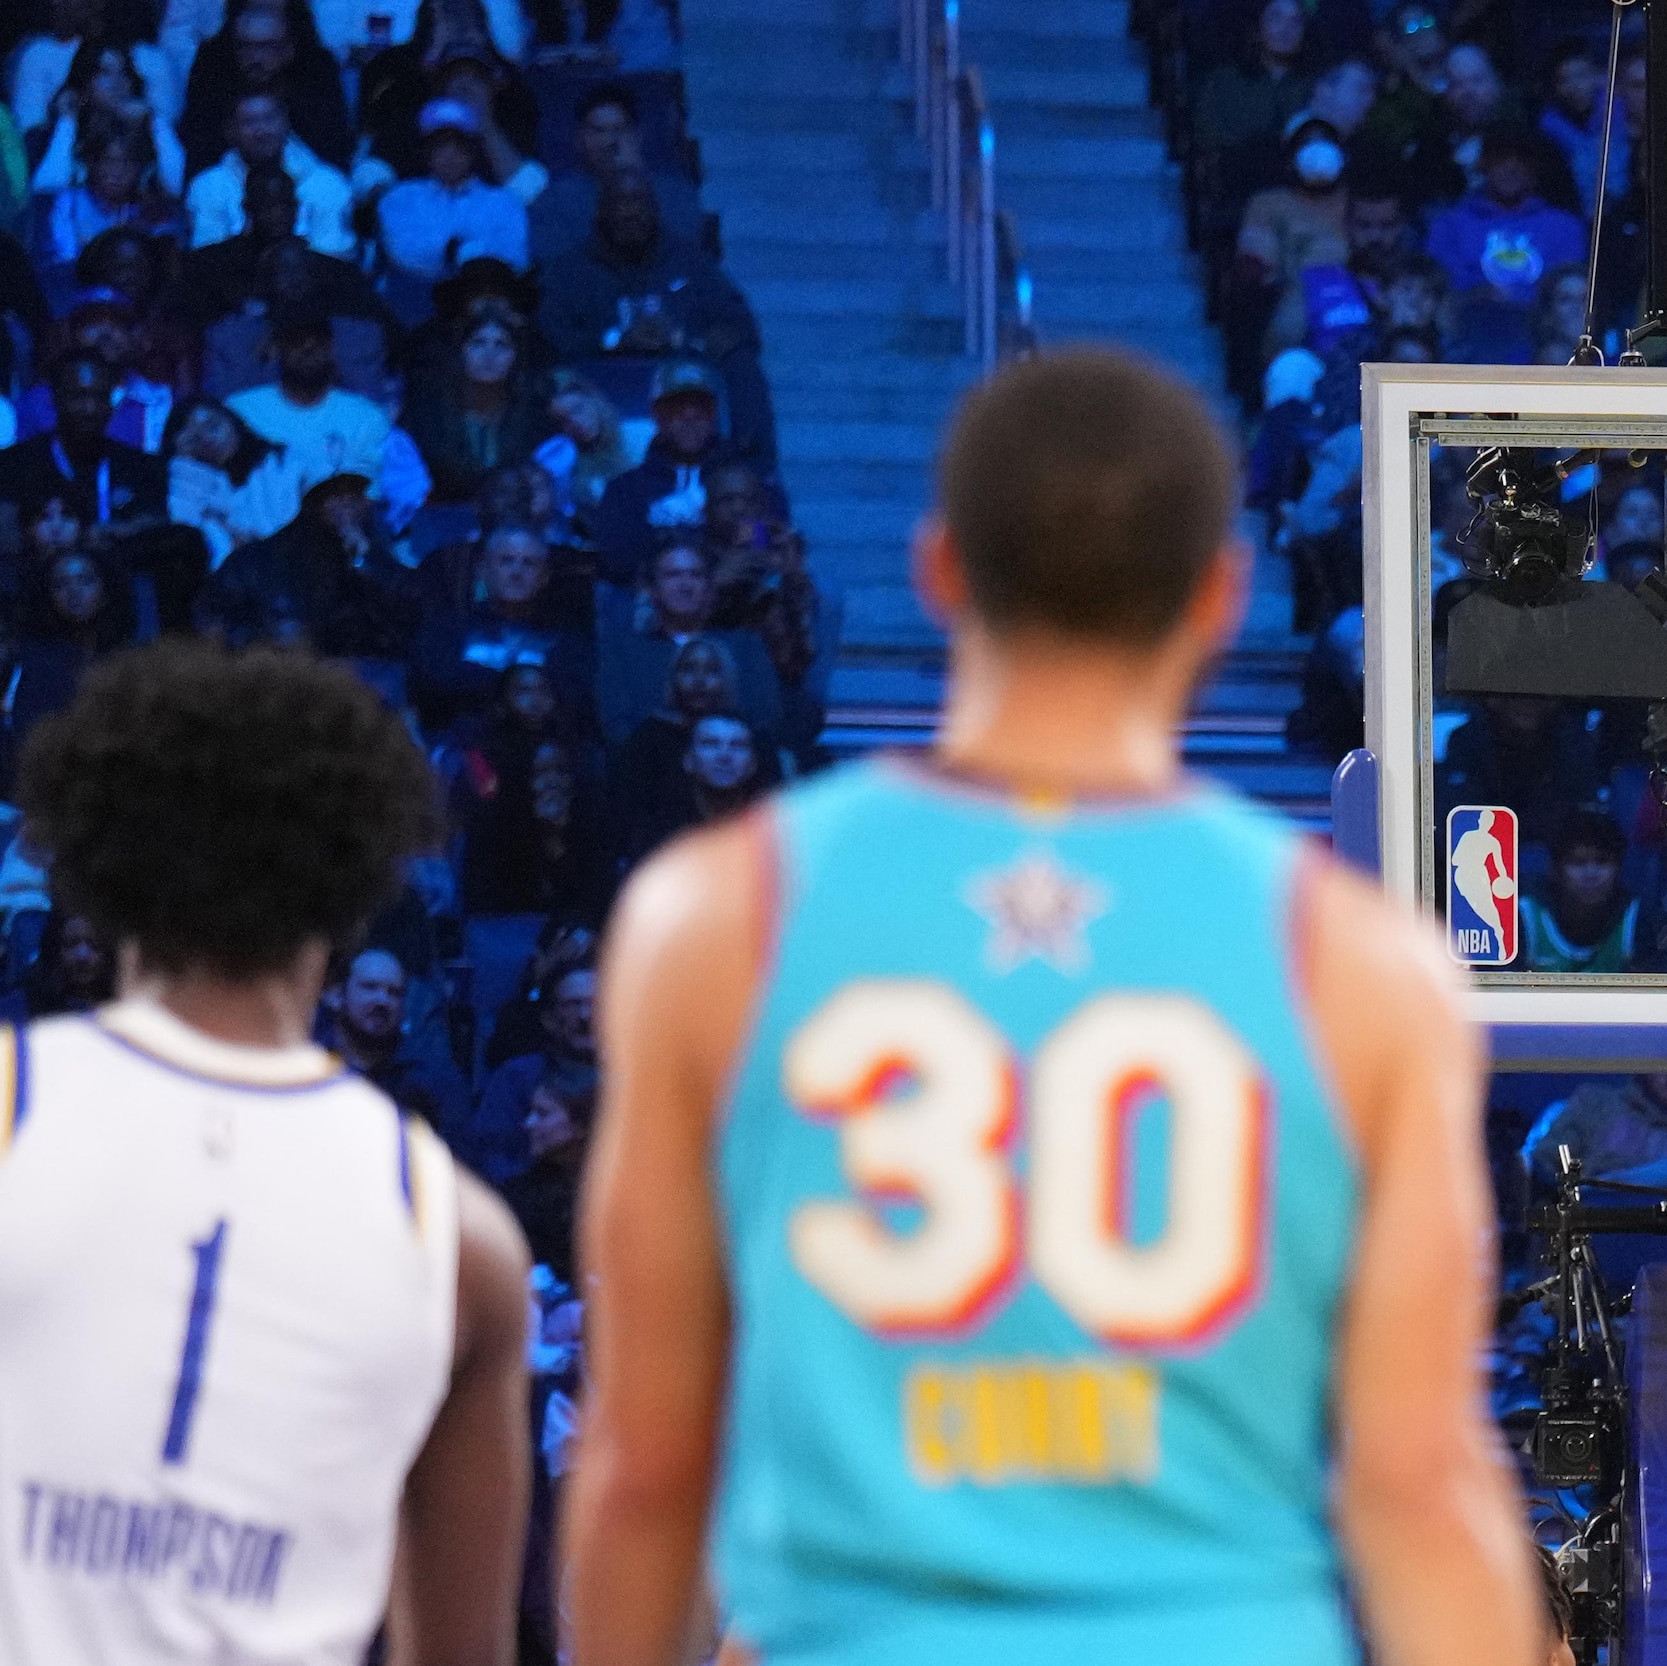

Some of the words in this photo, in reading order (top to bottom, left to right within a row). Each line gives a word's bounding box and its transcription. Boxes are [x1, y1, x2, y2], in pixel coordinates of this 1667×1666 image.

[1458, 928, 1491, 954] NBA
[782, 977, 1277, 1356] 30
[162, 1215, 228, 1464] 1
[21, 1482, 291, 1606] THOMPSON
